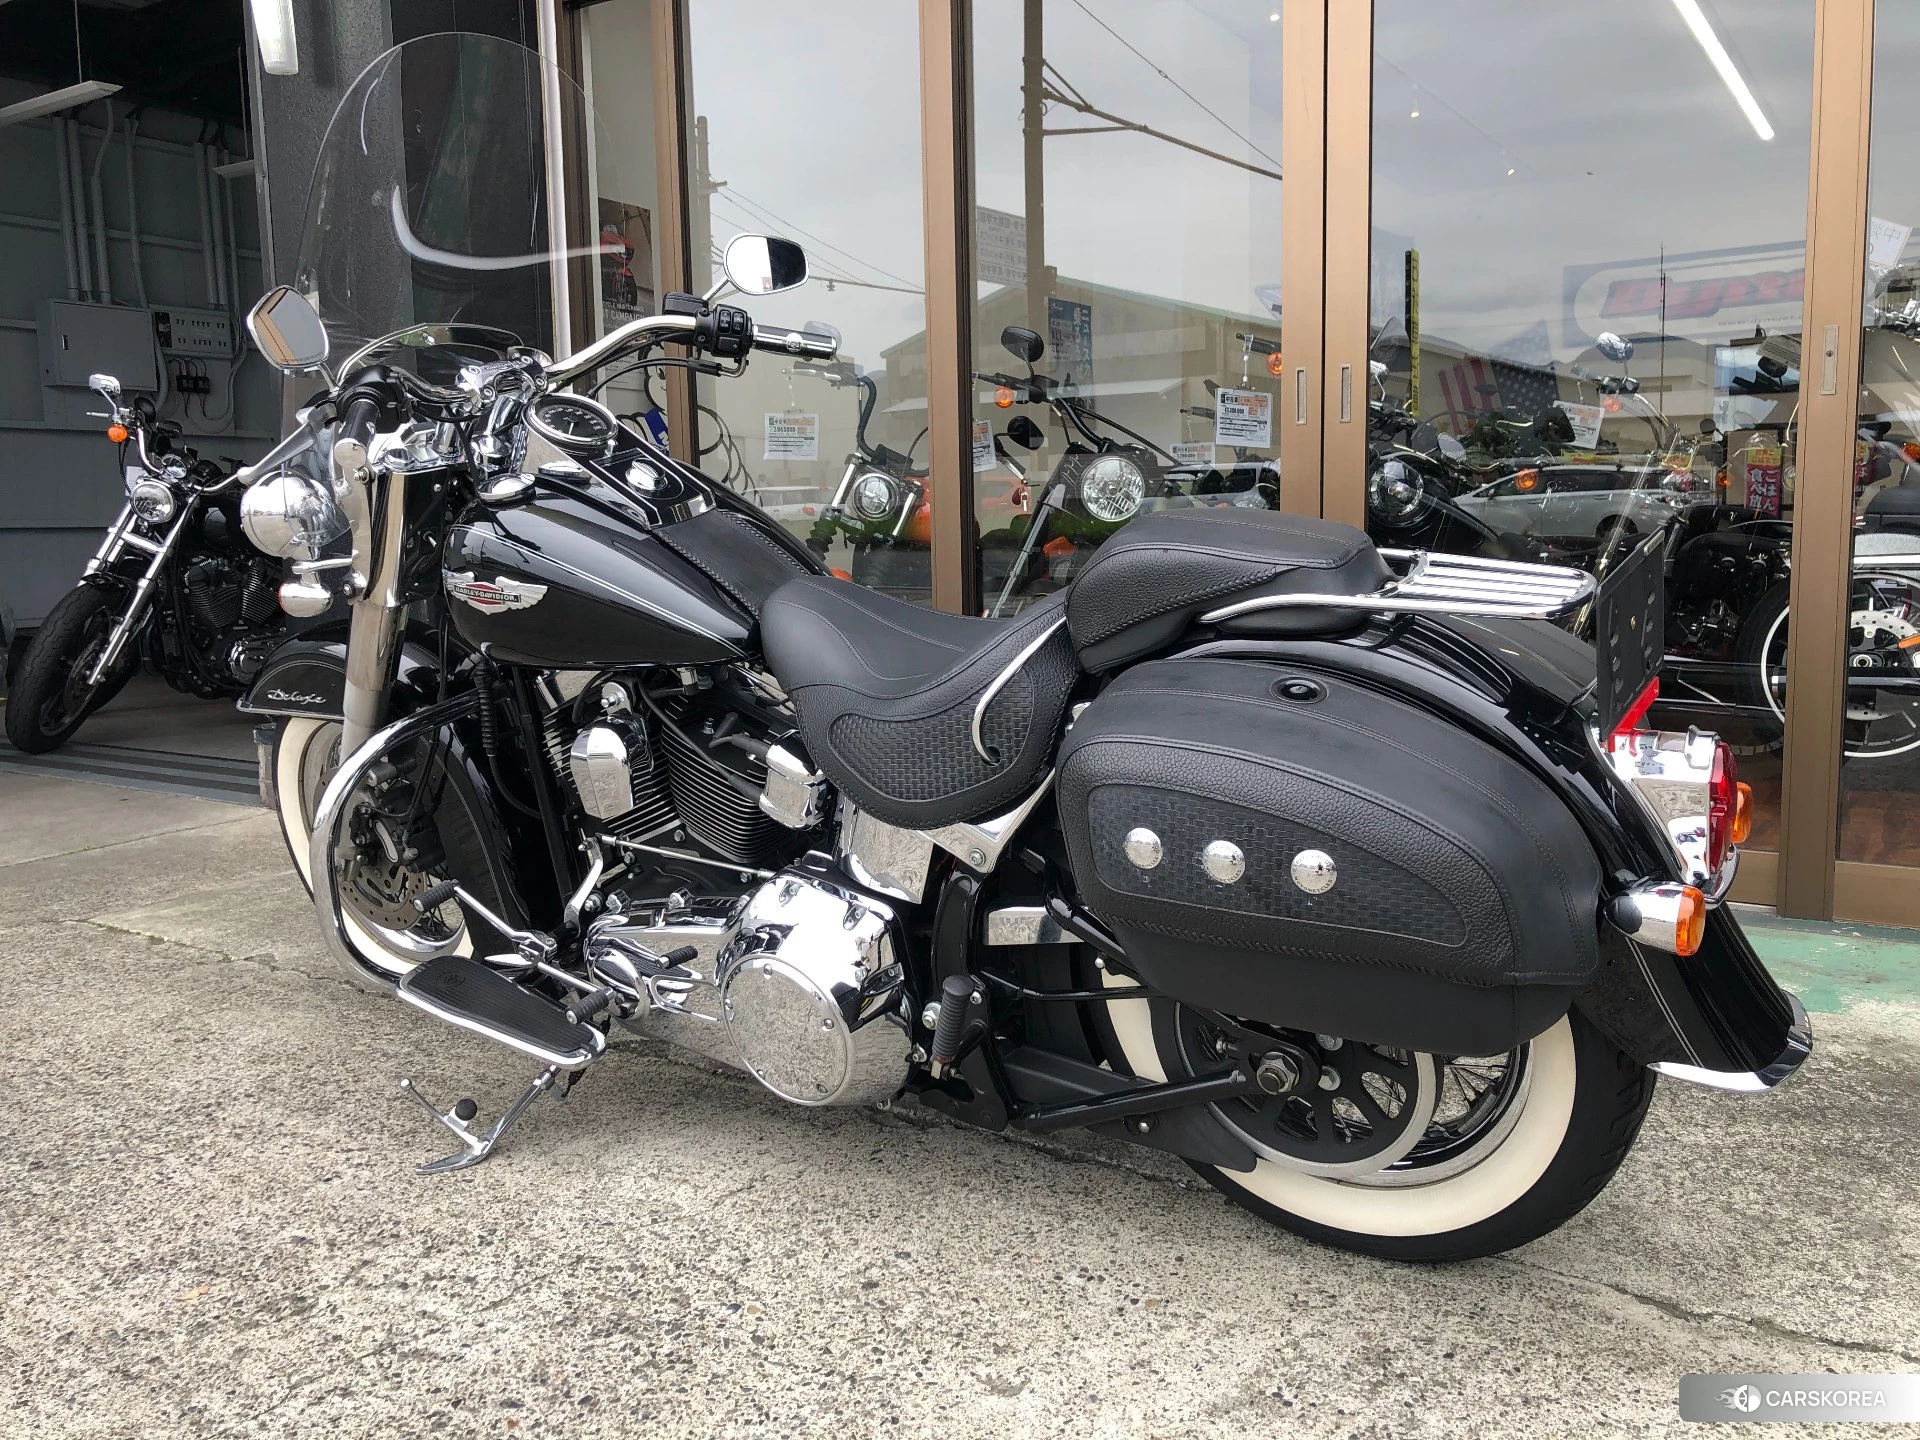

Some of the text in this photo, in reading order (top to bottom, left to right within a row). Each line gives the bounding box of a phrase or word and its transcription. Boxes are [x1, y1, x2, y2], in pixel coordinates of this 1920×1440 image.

[1763, 469, 1781, 510] ごはん
[267, 689, 327, 705] Deluxe
